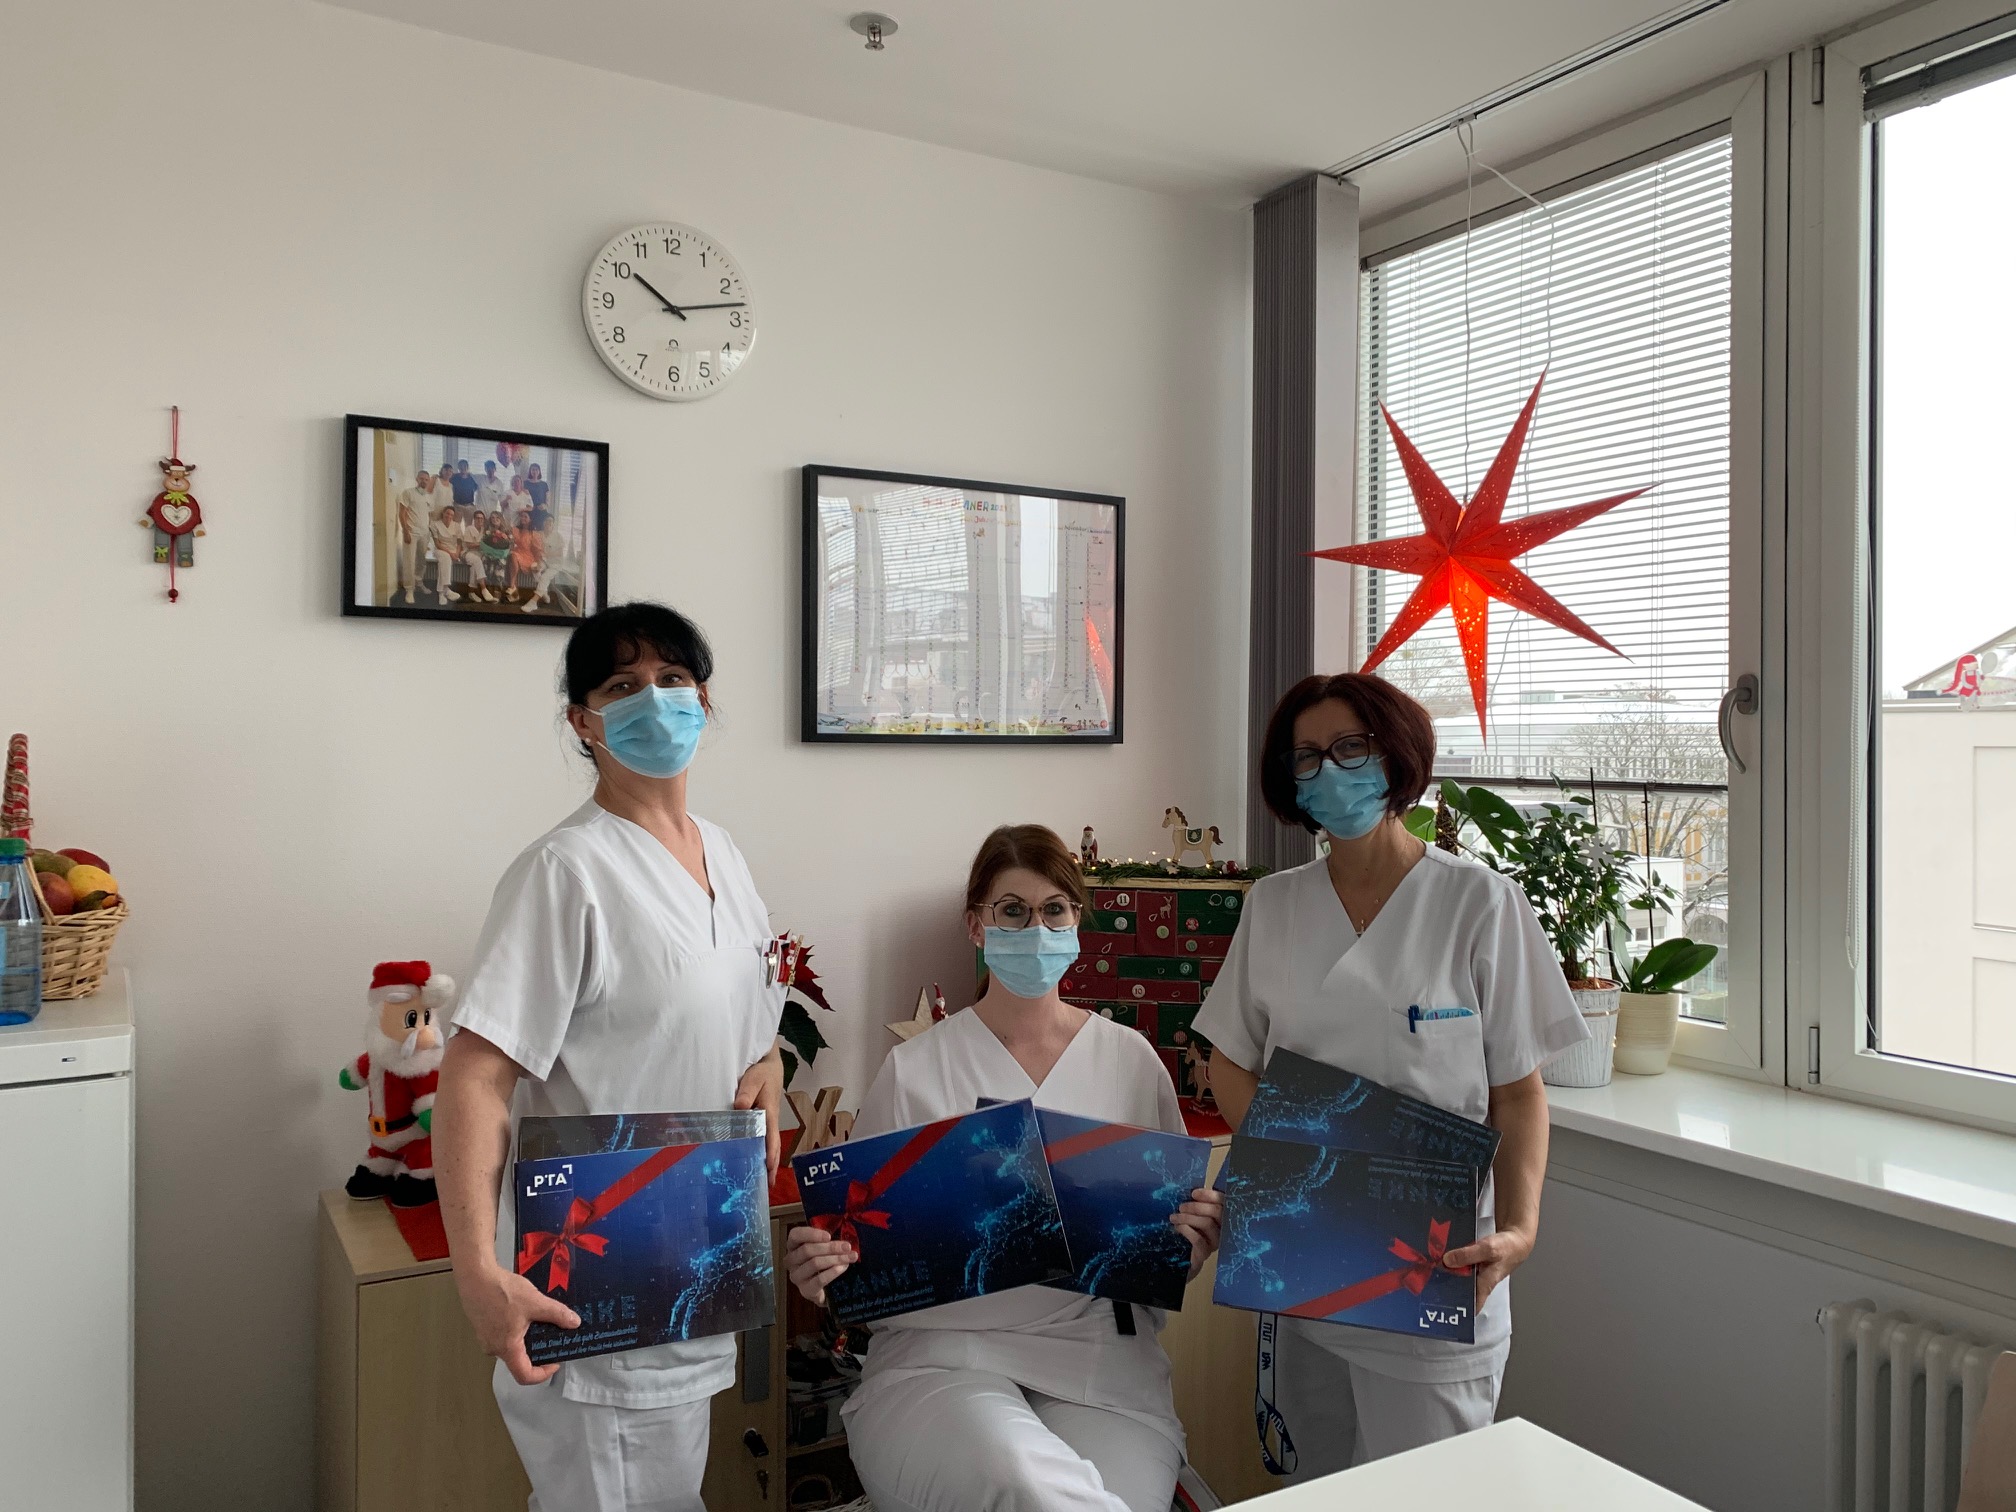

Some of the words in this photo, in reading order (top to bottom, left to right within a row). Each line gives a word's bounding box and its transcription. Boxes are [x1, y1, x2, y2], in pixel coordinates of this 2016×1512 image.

[633, 242, 647, 259] 11
[662, 237, 681, 256] 12
[699, 251, 706, 268] 1
[611, 261, 631, 279] 10
[719, 278, 731, 295] 2
[602, 292, 615, 309] 9
[729, 311, 742, 328] 3
[612, 326, 626, 343] 8
[721, 342, 731, 358] 4
[636, 352, 648, 370] 7
[698, 361, 711, 378] 5
[668, 366, 680, 383] 6
[1118, 895, 1128, 904] 11
[1227, 898, 1235, 907] 8
[1182, 965, 1190, 974] 9
[809, 1160, 841, 1178] PTA
[533, 1172, 567, 1188] PTA
[1425, 1308, 1459, 1326] PTA
